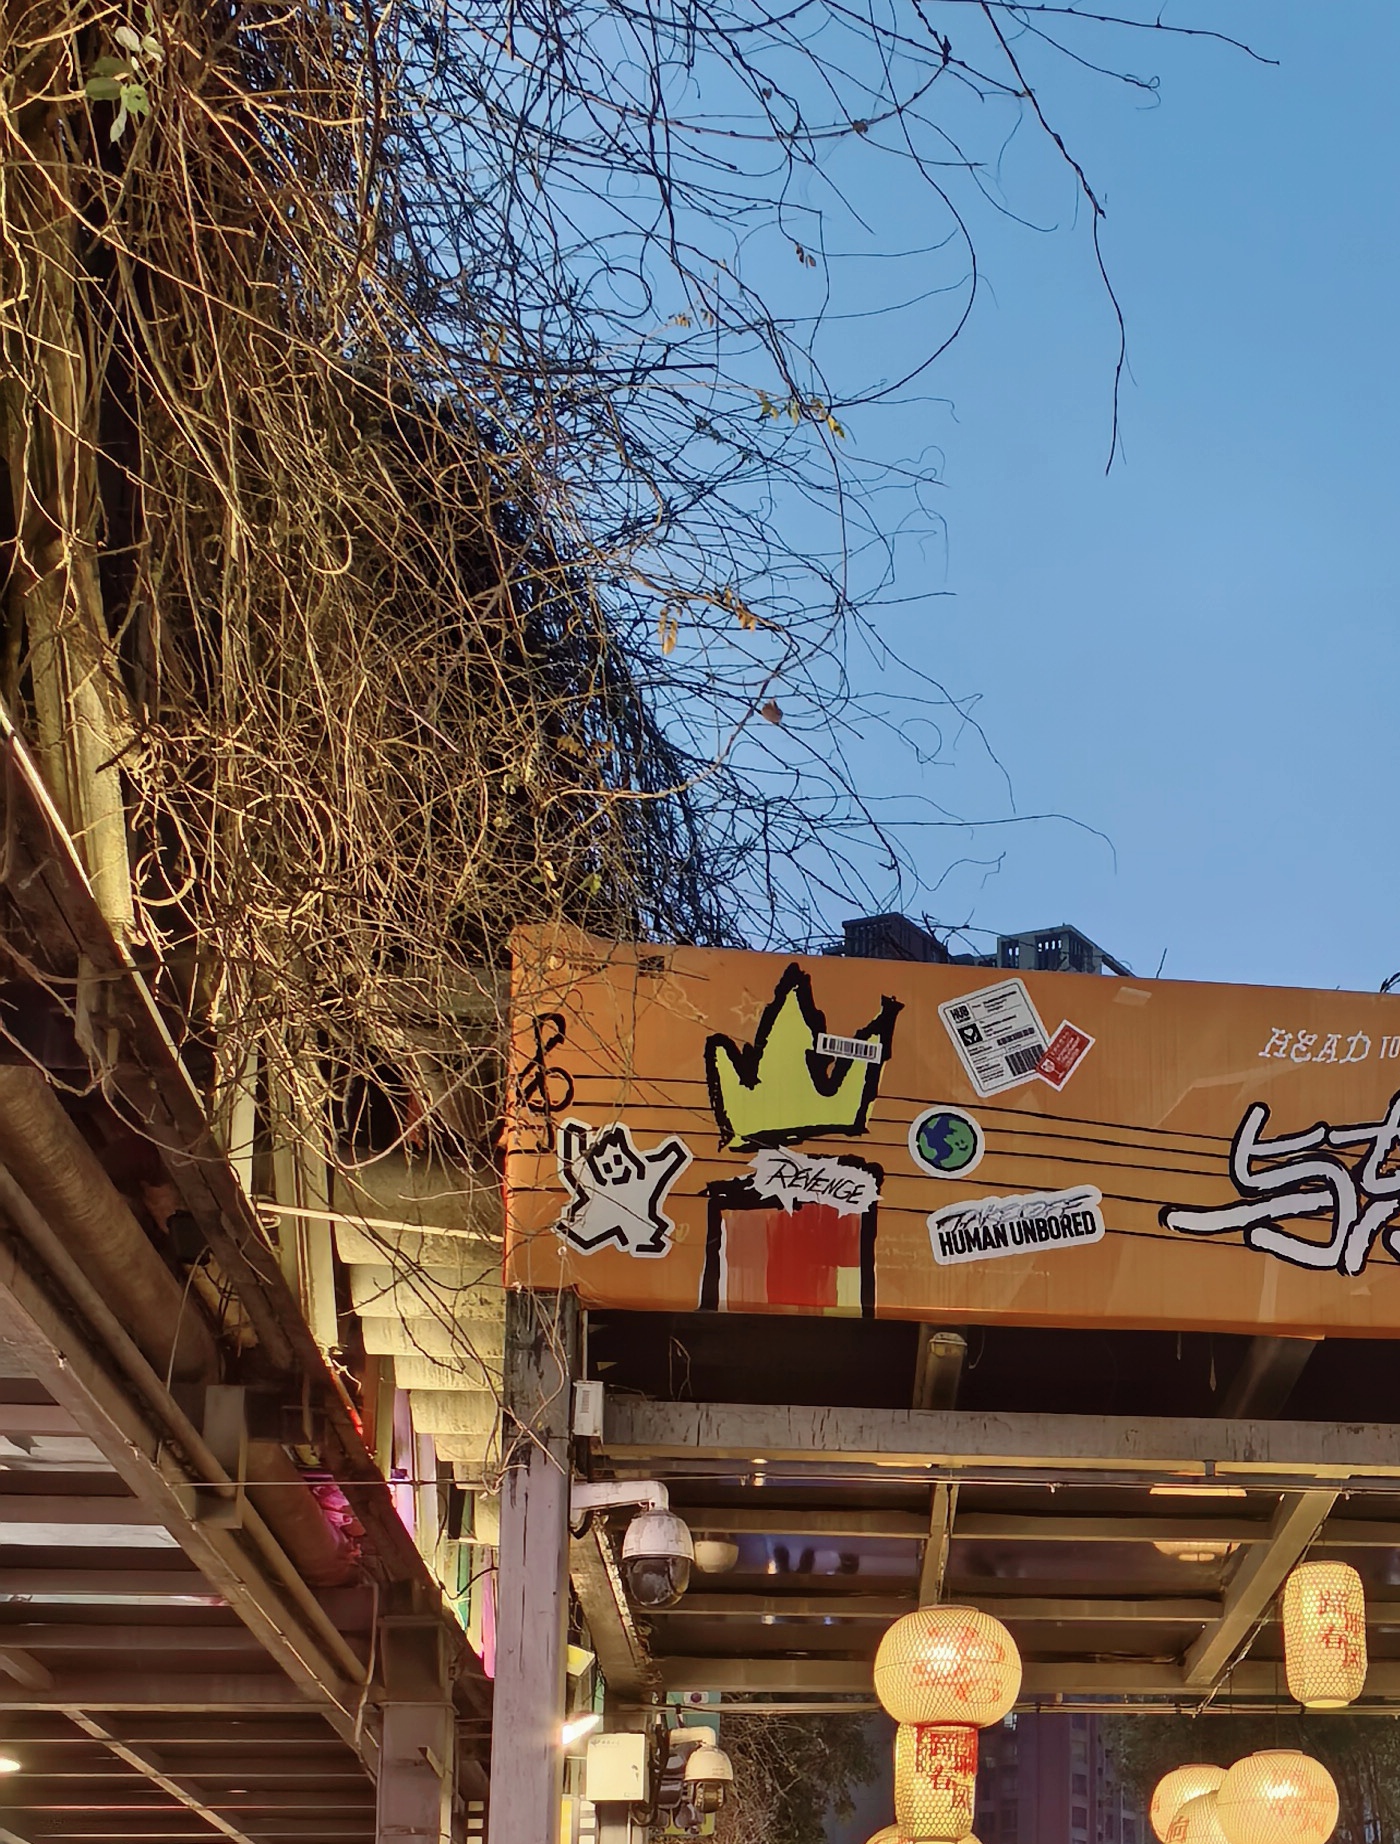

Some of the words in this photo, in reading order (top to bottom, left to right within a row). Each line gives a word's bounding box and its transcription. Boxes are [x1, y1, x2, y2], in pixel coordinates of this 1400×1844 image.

[766, 1158, 866, 1205] REVENGE
[938, 1223, 1010, 1257] HUMAN
[1009, 1210, 1097, 1248] UNBORED
